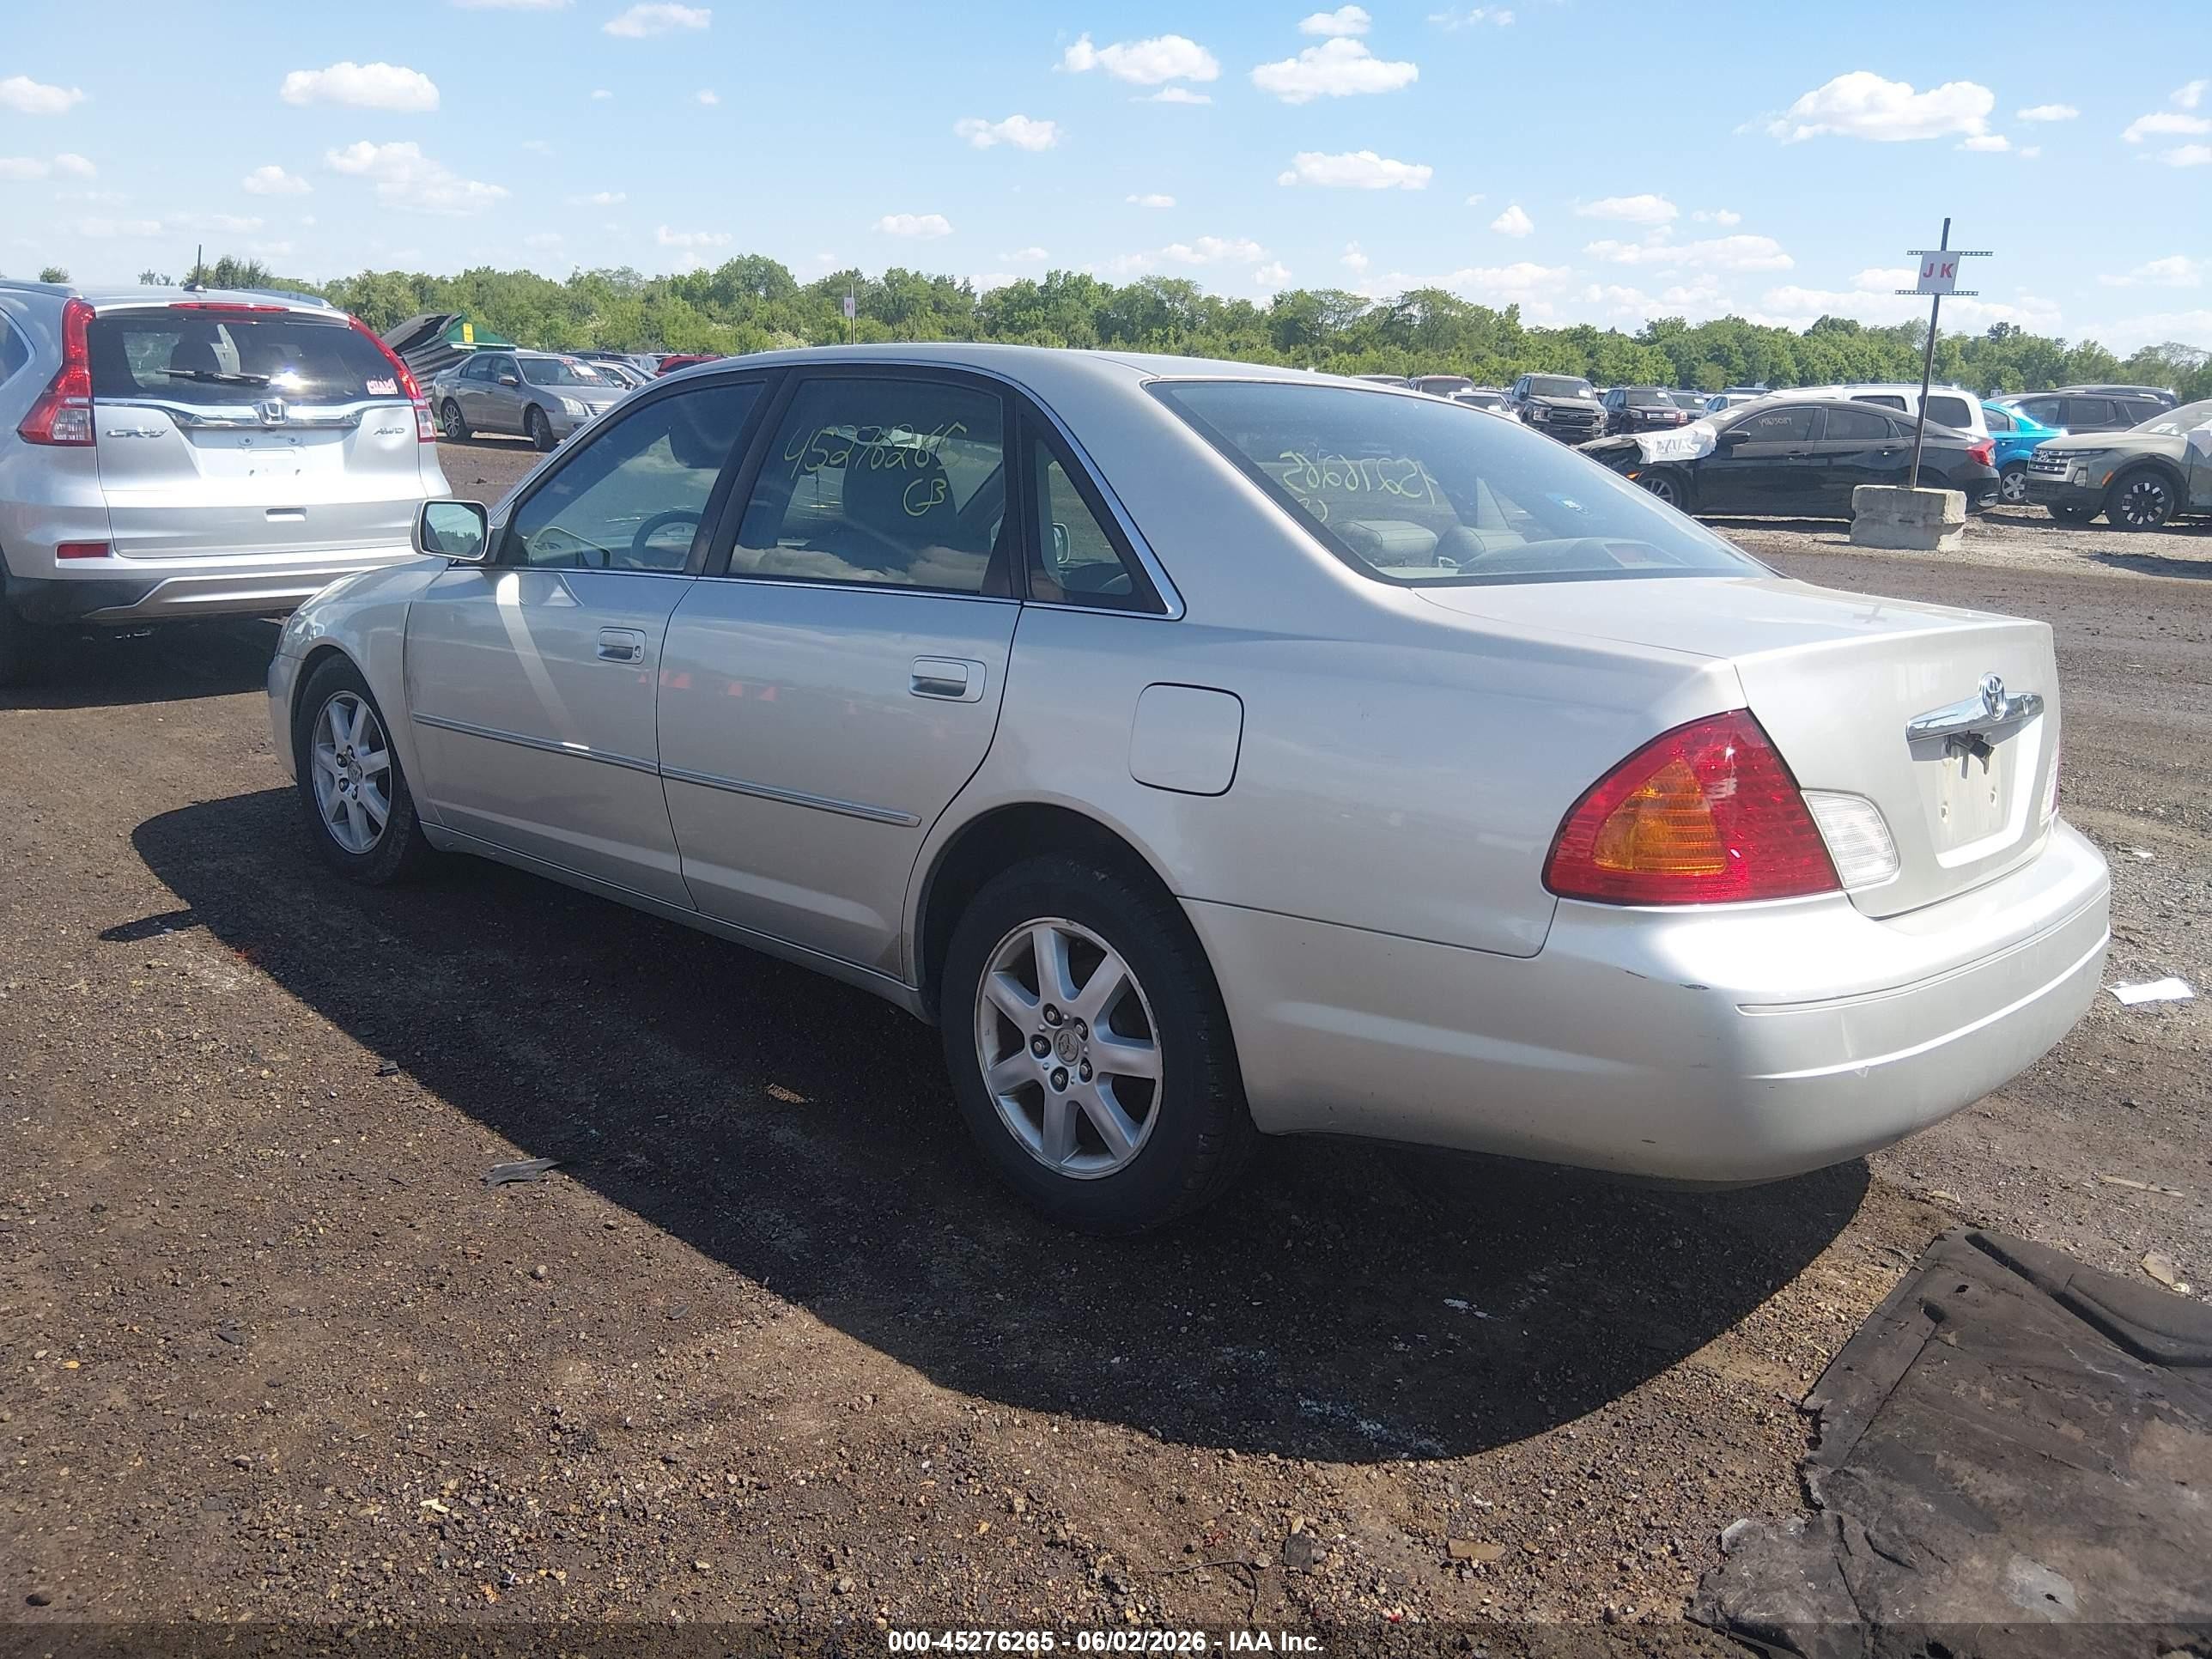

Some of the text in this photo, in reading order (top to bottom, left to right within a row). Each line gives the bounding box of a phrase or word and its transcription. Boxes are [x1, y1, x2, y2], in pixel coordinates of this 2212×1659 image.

[1923, 263, 1954, 278] J K
[106, 428, 169, 439] CR-V
[373, 427, 406, 435] AWD
[784, 422, 968, 479] 45276265
